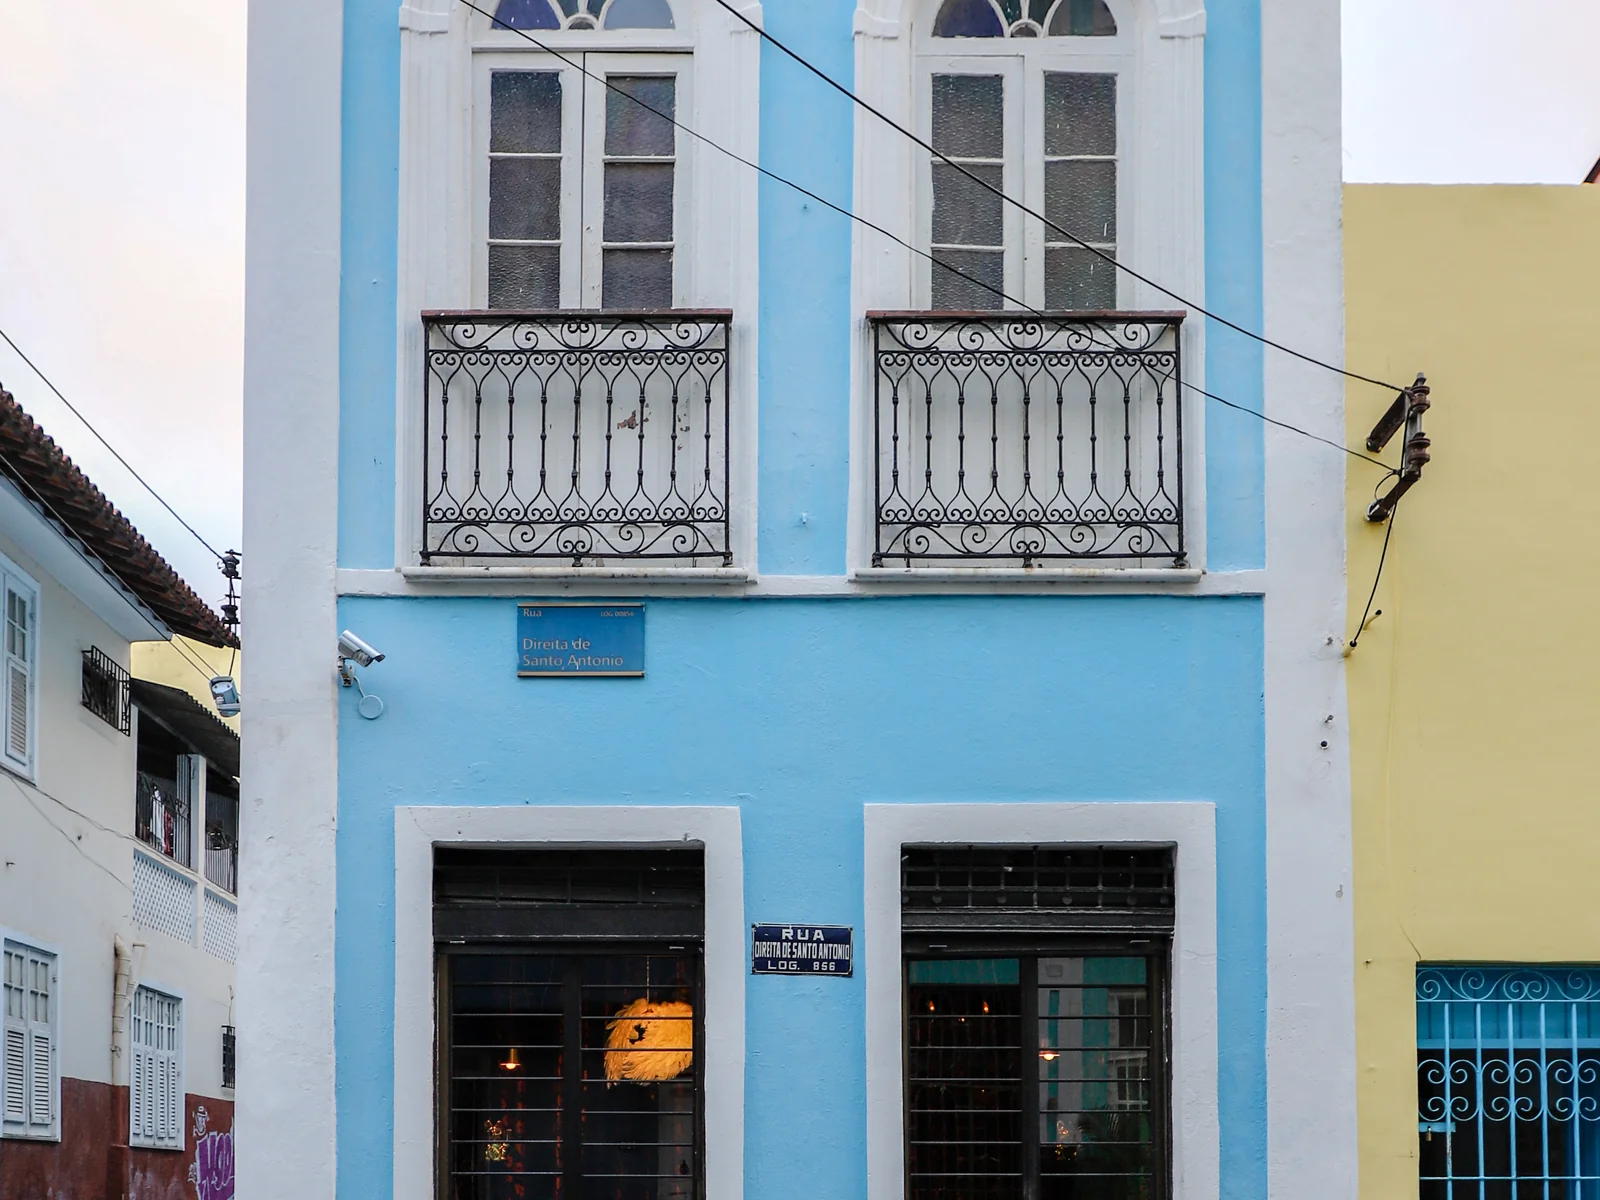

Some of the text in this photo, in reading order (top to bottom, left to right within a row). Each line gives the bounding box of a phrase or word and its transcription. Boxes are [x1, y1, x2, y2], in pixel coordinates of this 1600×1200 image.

[523, 608, 542, 617] Rua
[523, 638, 591, 650] Direita de
[523, 654, 624, 667] Santo Antonio
[781, 928, 825, 941] RUA
[755, 941, 850, 960] DIREITA DE SANTO ANTONIO
[767, 960, 836, 971] LOG. 856
